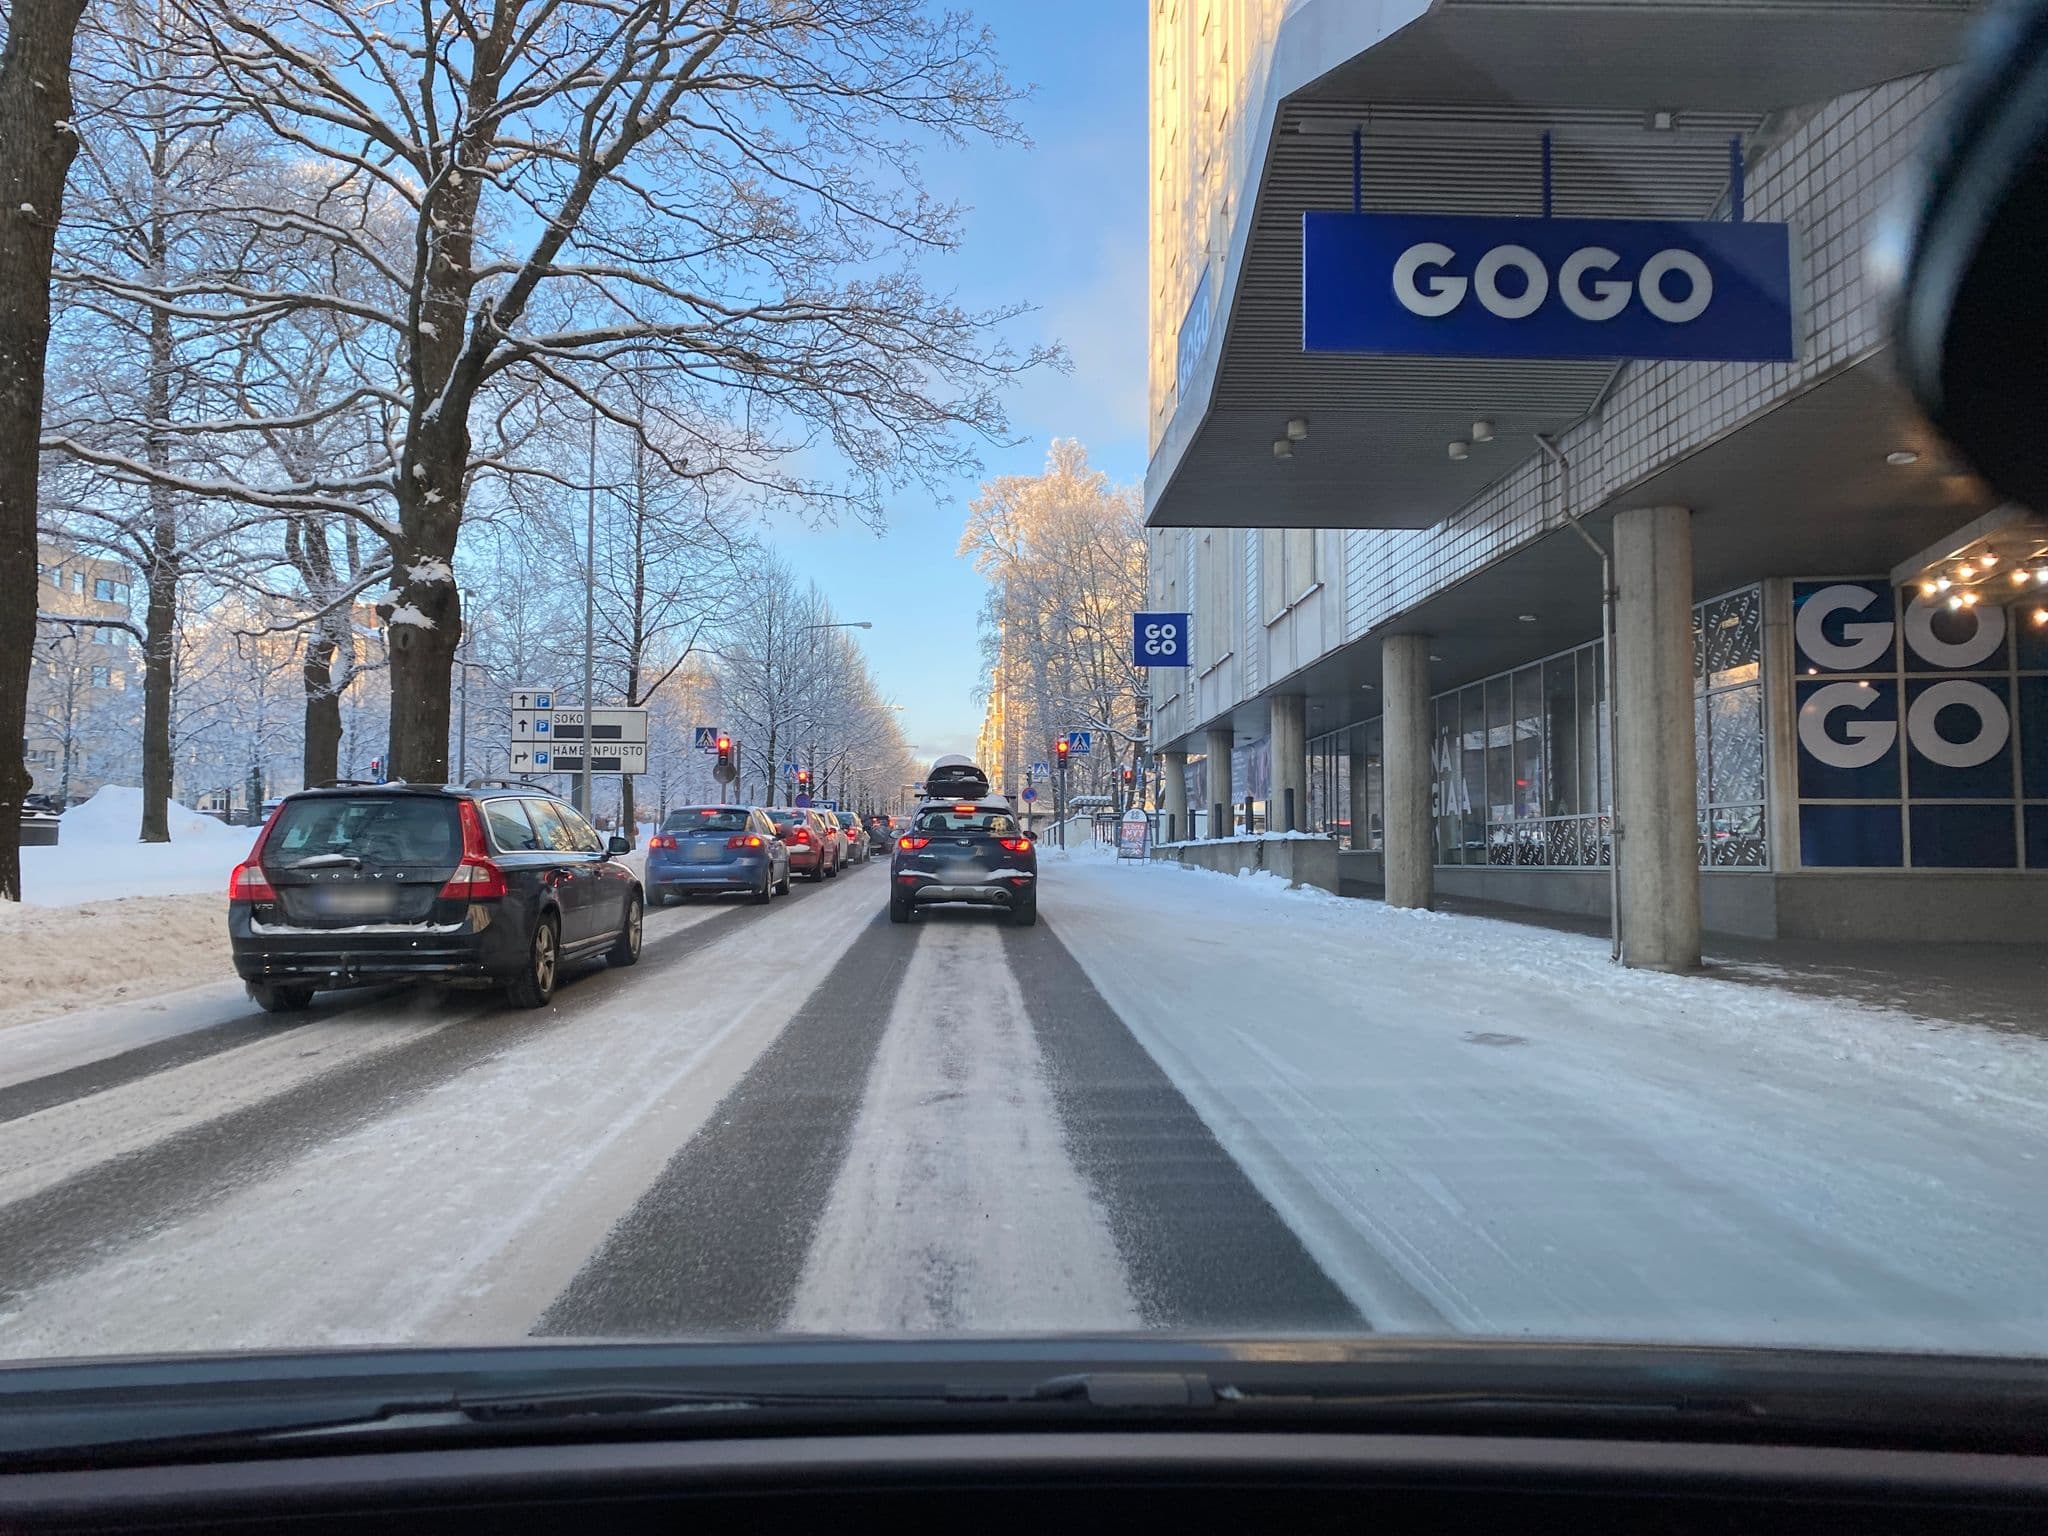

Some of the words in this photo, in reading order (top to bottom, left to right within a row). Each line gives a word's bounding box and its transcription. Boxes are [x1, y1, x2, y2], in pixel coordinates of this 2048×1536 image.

[1392, 242, 1713, 323] GOGO
[1144, 623, 1177, 639] GO
[1795, 584, 2006, 671] GO
[1144, 640, 1177, 656] GO
[1798, 679, 2011, 769] GO
[553, 745, 643, 756] HÄMENPUISTO
[255, 903, 274, 911] V70
